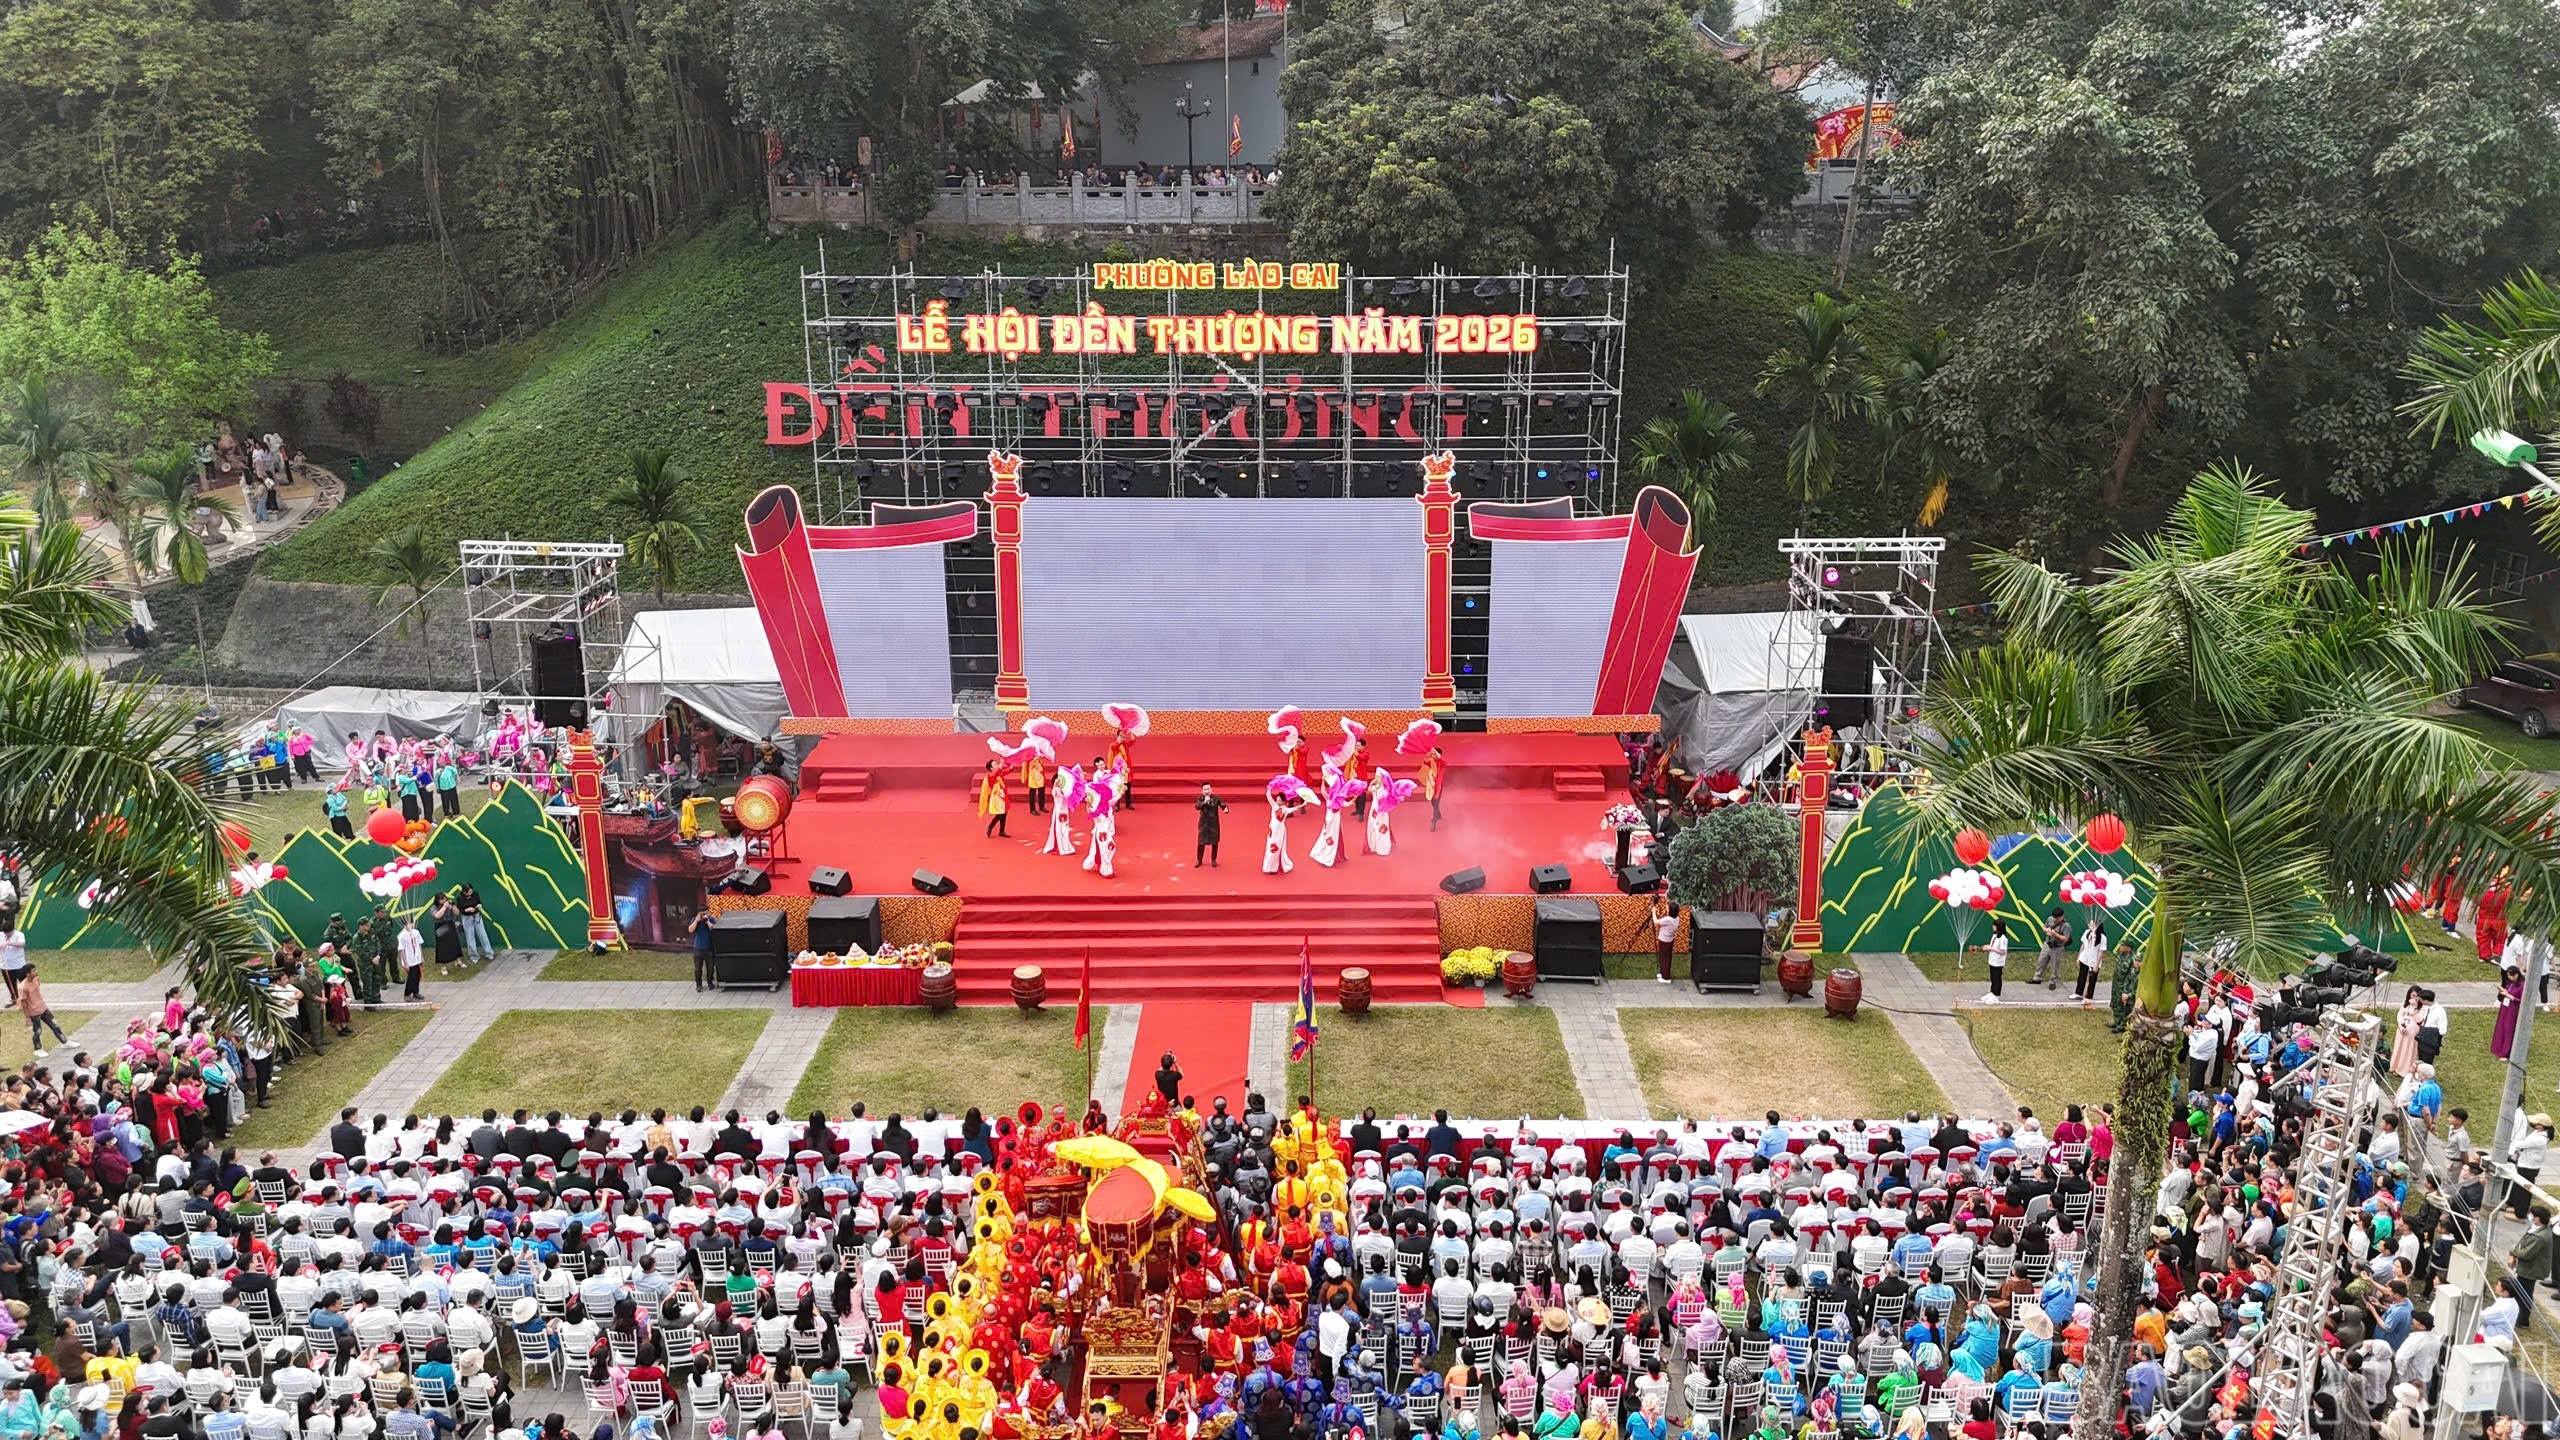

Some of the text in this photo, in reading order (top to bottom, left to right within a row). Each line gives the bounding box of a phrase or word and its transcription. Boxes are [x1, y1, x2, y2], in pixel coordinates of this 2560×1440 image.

[1093, 257, 1340, 290] PHƯỜNG LÀO CAI
[897, 300, 1538, 361] LỄ HỘI ĐỀN THƯỢNG NĂM 2026
